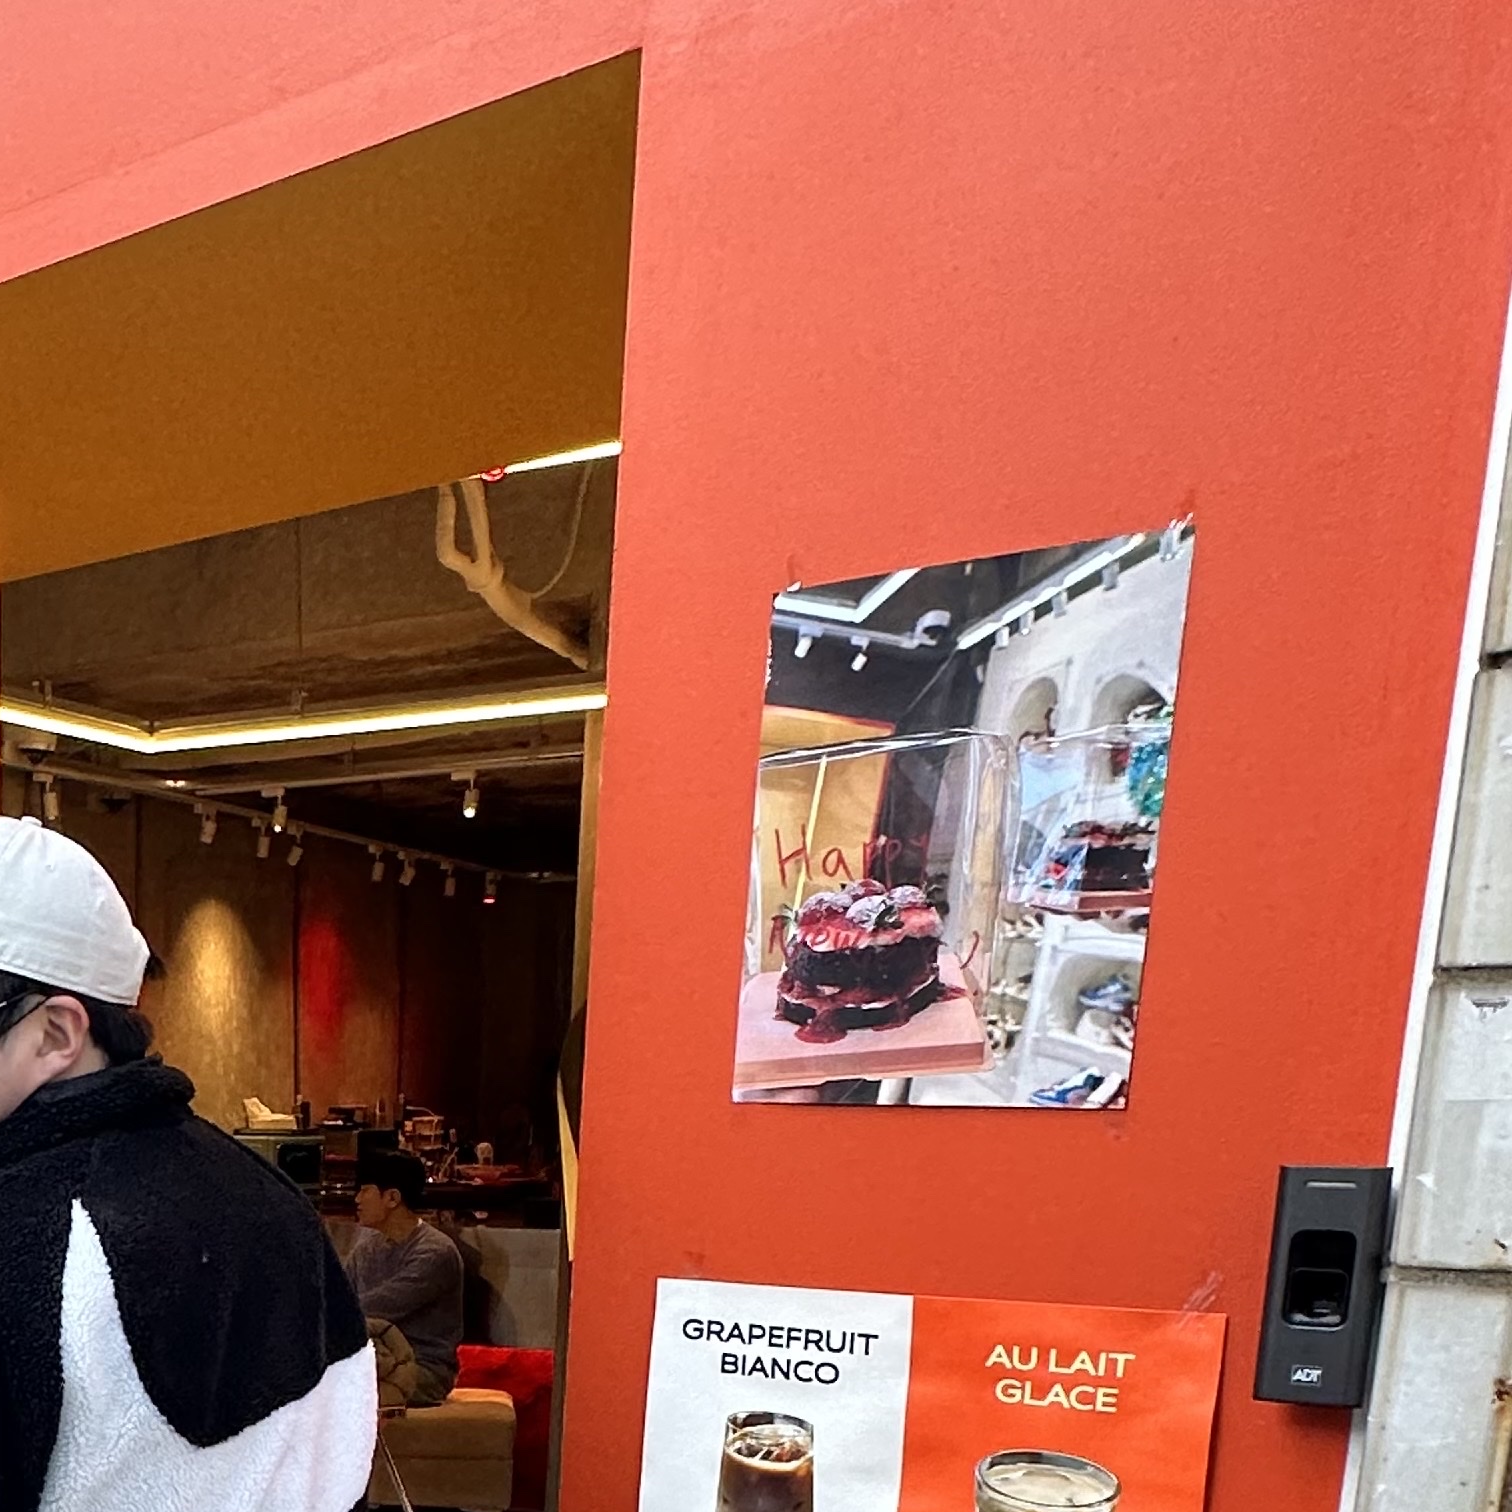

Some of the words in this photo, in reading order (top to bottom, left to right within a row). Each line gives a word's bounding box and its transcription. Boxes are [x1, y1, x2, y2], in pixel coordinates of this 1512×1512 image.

[682, 1318, 880, 1356] GRAPEFRUIT
[720, 1352, 840, 1385] BIANCO
[985, 1344, 1038, 1371] AU
[1048, 1348, 1137, 1378] LAIT
[1292, 1367, 1322, 1384] ADT
[994, 1378, 1120, 1413] GLACE
